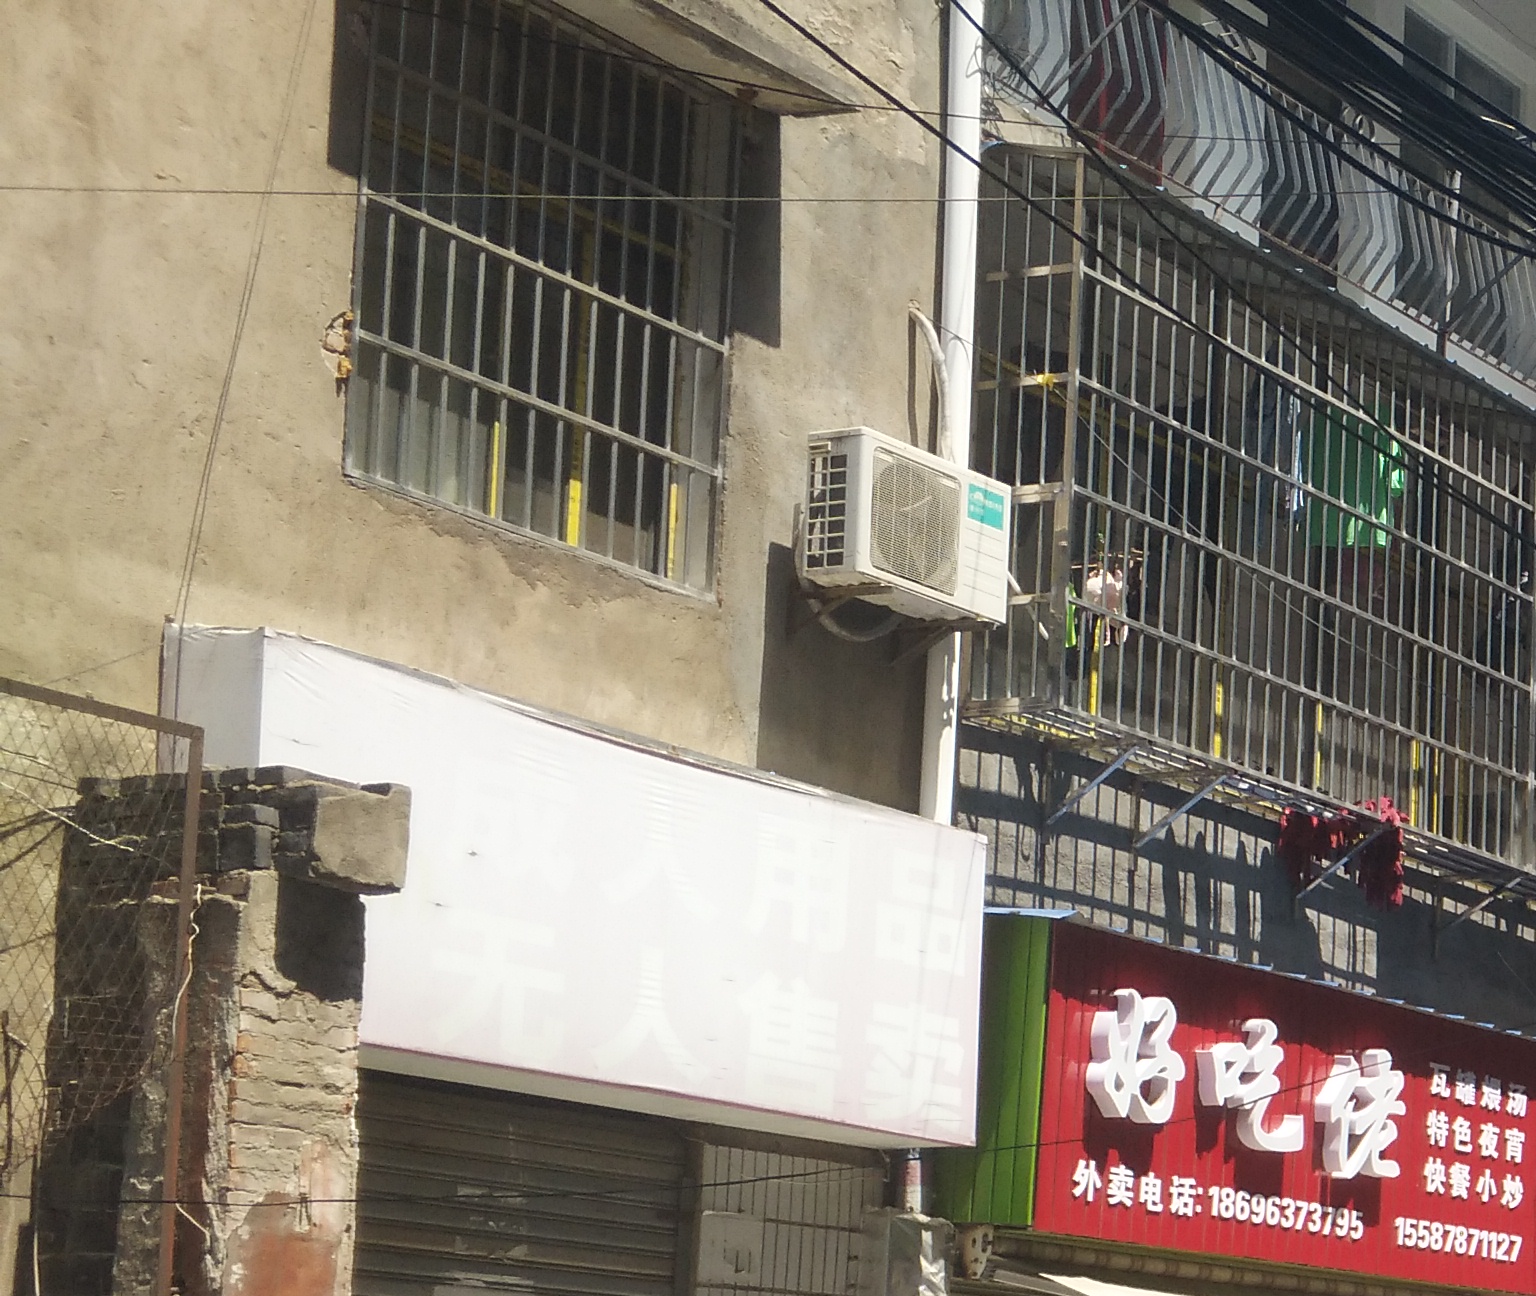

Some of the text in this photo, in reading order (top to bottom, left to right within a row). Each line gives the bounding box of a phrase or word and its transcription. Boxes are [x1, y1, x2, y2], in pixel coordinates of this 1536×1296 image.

[430, 908, 966, 1133] 无人售卖
[1428, 1061, 1528, 1118] 瓦罐煨汤
[1425, 1109, 1526, 1165] 特色夜宵
[1423, 1156, 1525, 1210] 快餐小炒
[1394, 1215, 1523, 1263] 15587871127
